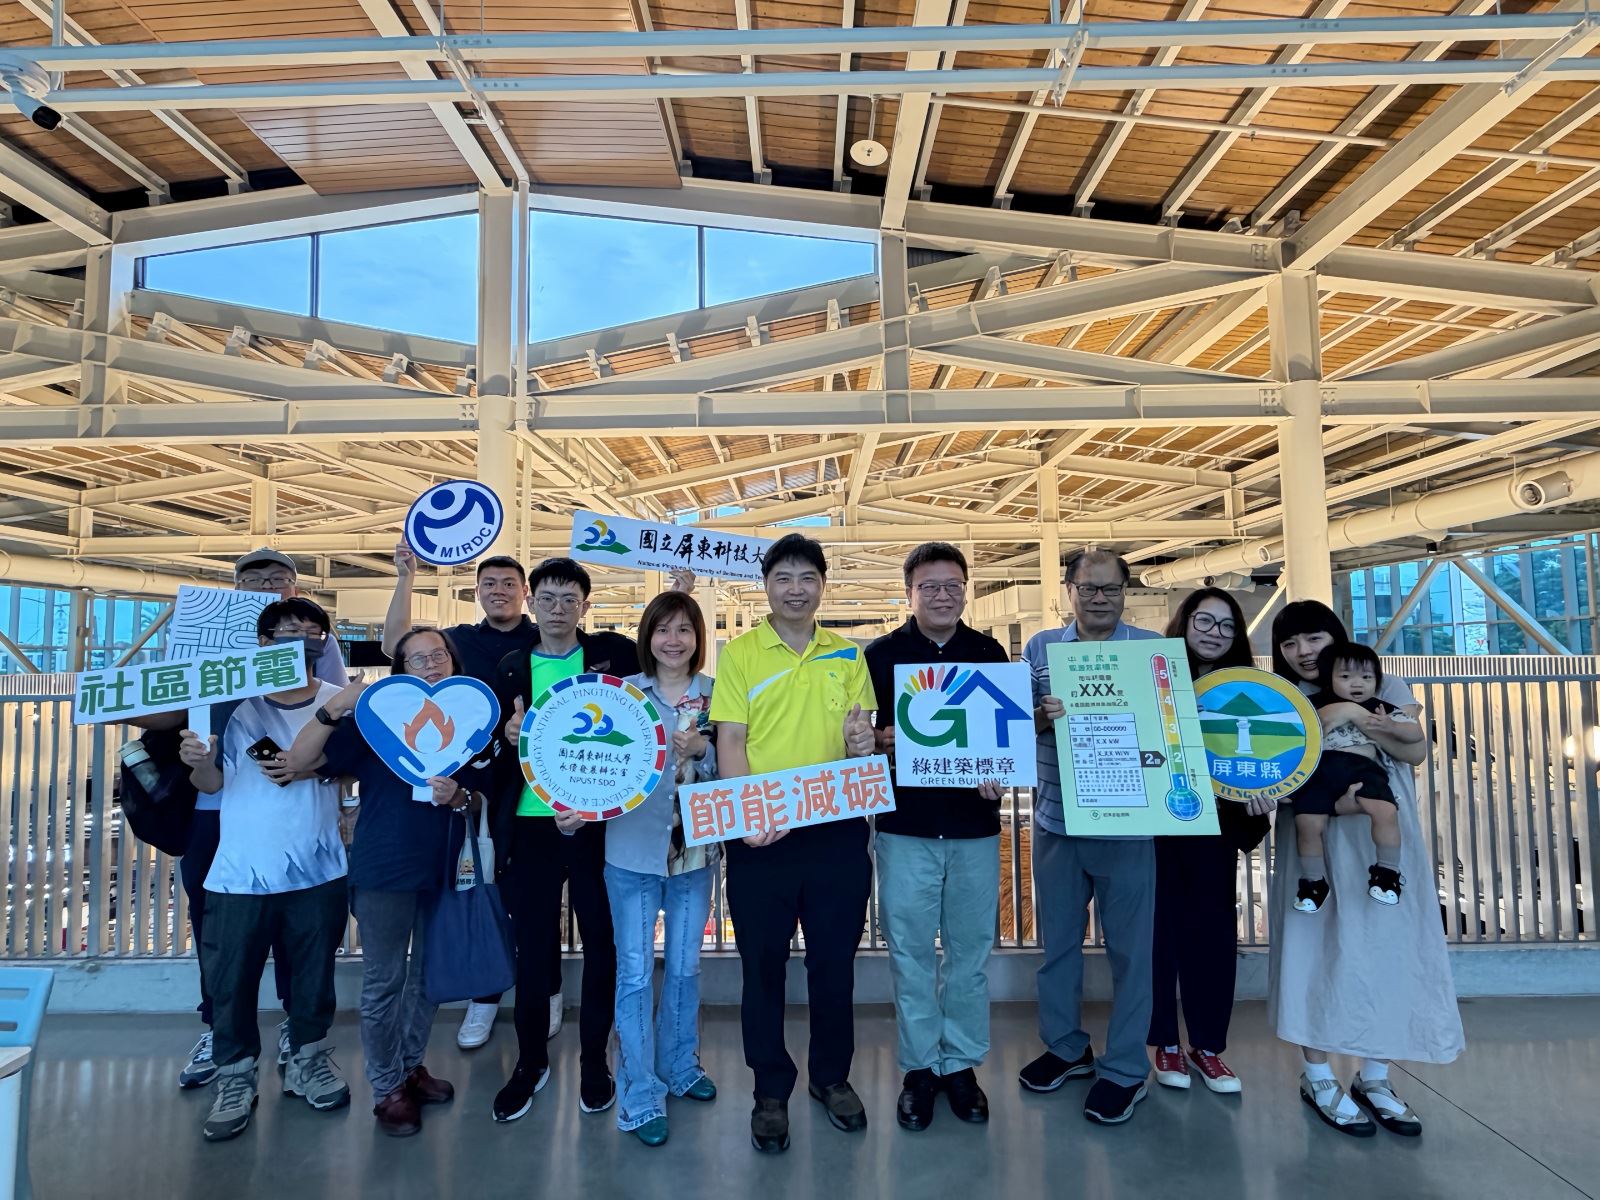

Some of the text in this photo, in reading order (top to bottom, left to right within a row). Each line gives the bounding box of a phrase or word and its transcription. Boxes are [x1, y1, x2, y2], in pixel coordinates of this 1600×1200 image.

[440, 527, 492, 558] MIRDC
[639, 529, 764, 565] 國立屏東科技大
[78, 646, 302, 716] 社區節電
[1159, 670, 1168, 680] 5
[572, 687, 628, 706] PINGTUNG
[1164, 696, 1172, 706] 4
[533, 697, 570, 742] NATIONAL
[1169, 723, 1177, 734] 3
[628, 703, 653, 766] UNIVERSITY
[912, 757, 1016, 776] 綠建築標章
[1174, 752, 1182, 763] 2
[635, 769, 647, 785] OF
[1212, 759, 1282, 780] 屏東縣
[569, 776, 616, 787] NPUST SDO
[920, 777, 955, 786] GREEN
[1179, 776, 1185, 787] 1
[688, 762, 890, 840] 節能減碳
